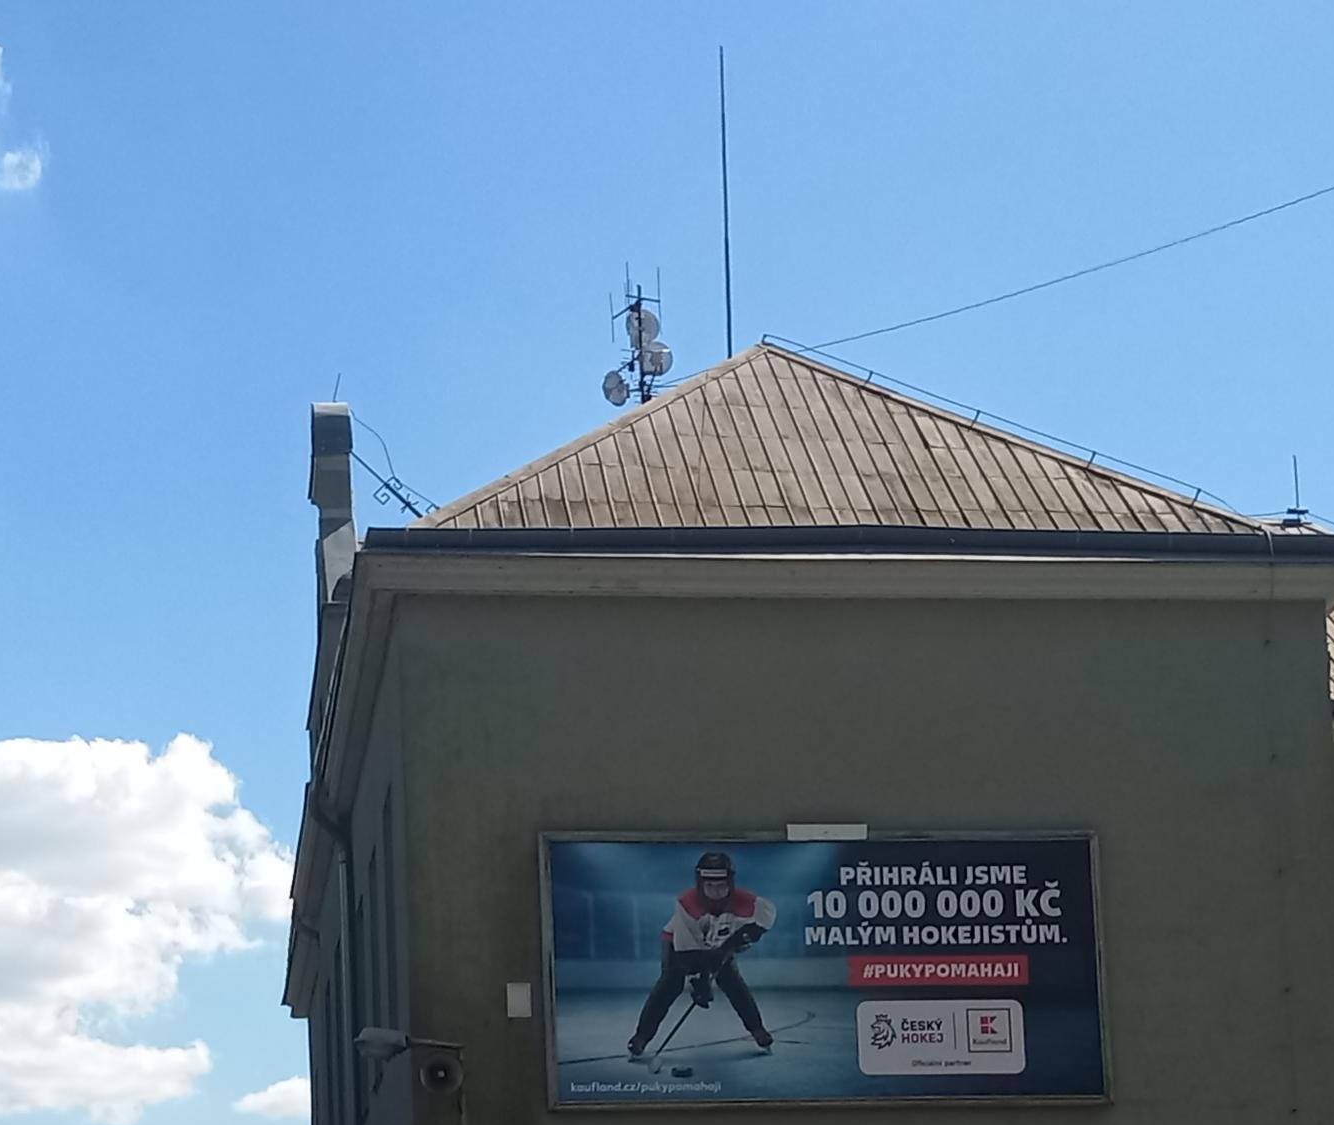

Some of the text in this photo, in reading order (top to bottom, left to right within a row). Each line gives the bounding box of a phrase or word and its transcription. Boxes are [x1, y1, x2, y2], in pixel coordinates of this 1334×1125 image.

[839, 861, 1027, 886] PŘIHRÁLI JSME
[806, 880, 1062, 919] 10 000 000 KČ
[805, 919, 1068, 945] MALÝM HOKEJISTŮM.
[863, 962, 1020, 979] #PUKYPOMAHAJI
[900, 1018, 943, 1031] ČESKÝ
[901, 1033, 944, 1044] HOKEJ
